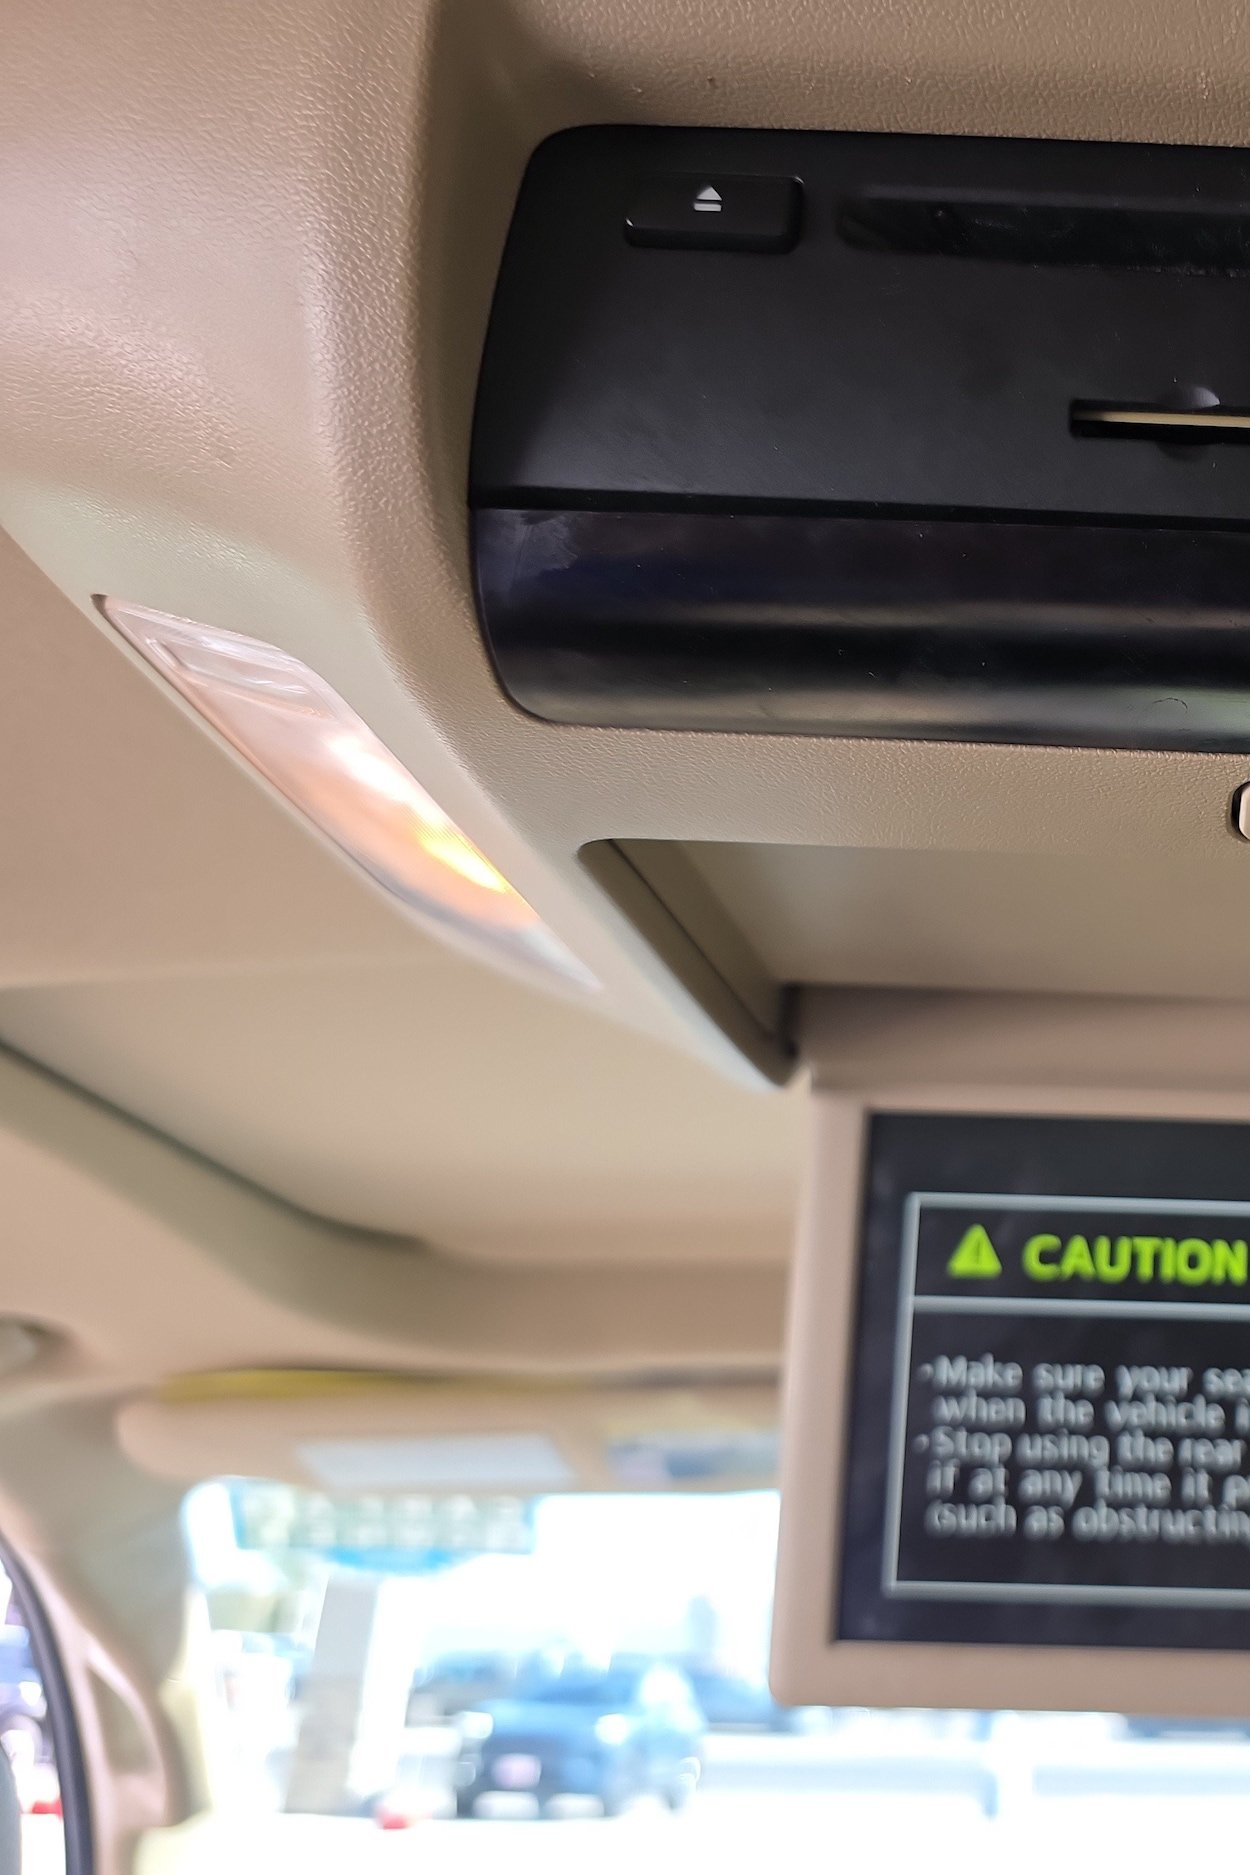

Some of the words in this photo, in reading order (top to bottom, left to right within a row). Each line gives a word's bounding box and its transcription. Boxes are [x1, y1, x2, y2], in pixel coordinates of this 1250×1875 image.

[1022, 1233, 1248, 1286] CAUTION
[1032, 1362, 1105, 1397] sure
[1115, 1364, 1192, 1400] your
[933, 1388, 1025, 1430] when
[1035, 1391, 1094, 1432] the
[1104, 1393, 1225, 1437] vehicle
[1015, 1429, 1109, 1471] using
[1117, 1430, 1173, 1470] the
[1177, 1438, 1246, 1473] rear
[926, 1458, 958, 1498] if
[968, 1464, 1008, 1500] at
[1018, 1468, 1081, 1508] any
[1095, 1466, 1171, 1506] time
[1182, 1467, 1212, 1507] it
[924, 1498, 1016, 1540] (such
[1024, 1505, 1064, 1541] as
